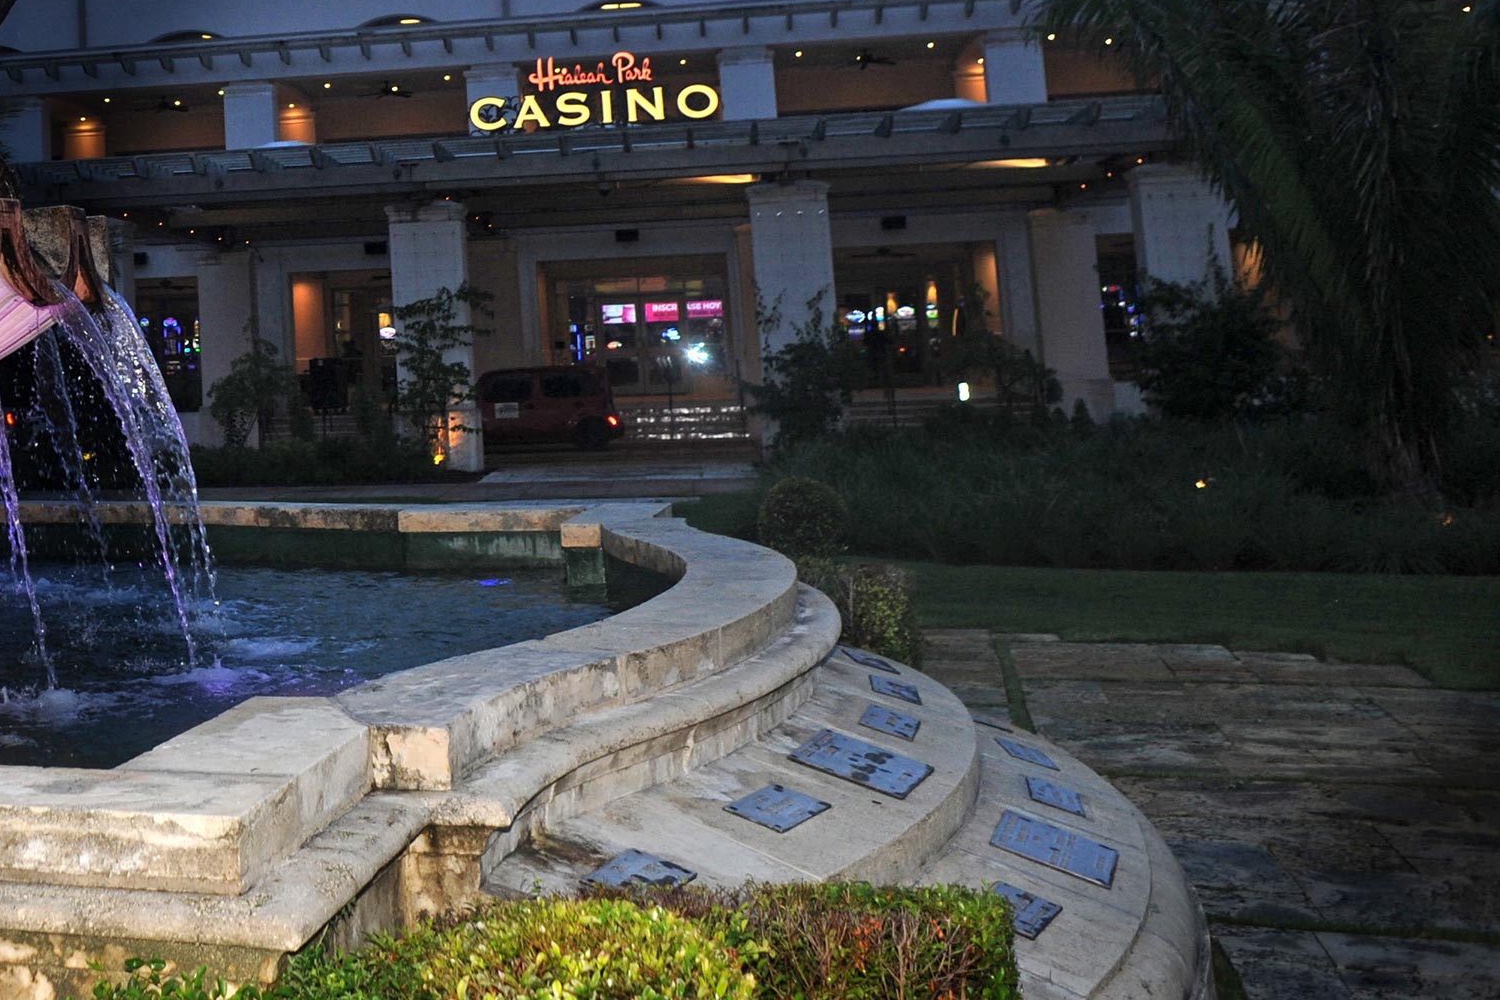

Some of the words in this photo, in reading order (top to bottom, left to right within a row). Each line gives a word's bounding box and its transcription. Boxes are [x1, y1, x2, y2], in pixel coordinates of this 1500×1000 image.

[528, 55, 613, 92] Hialeah
[611, 51, 652, 84] Park
[469, 84, 719, 131] CASINO
